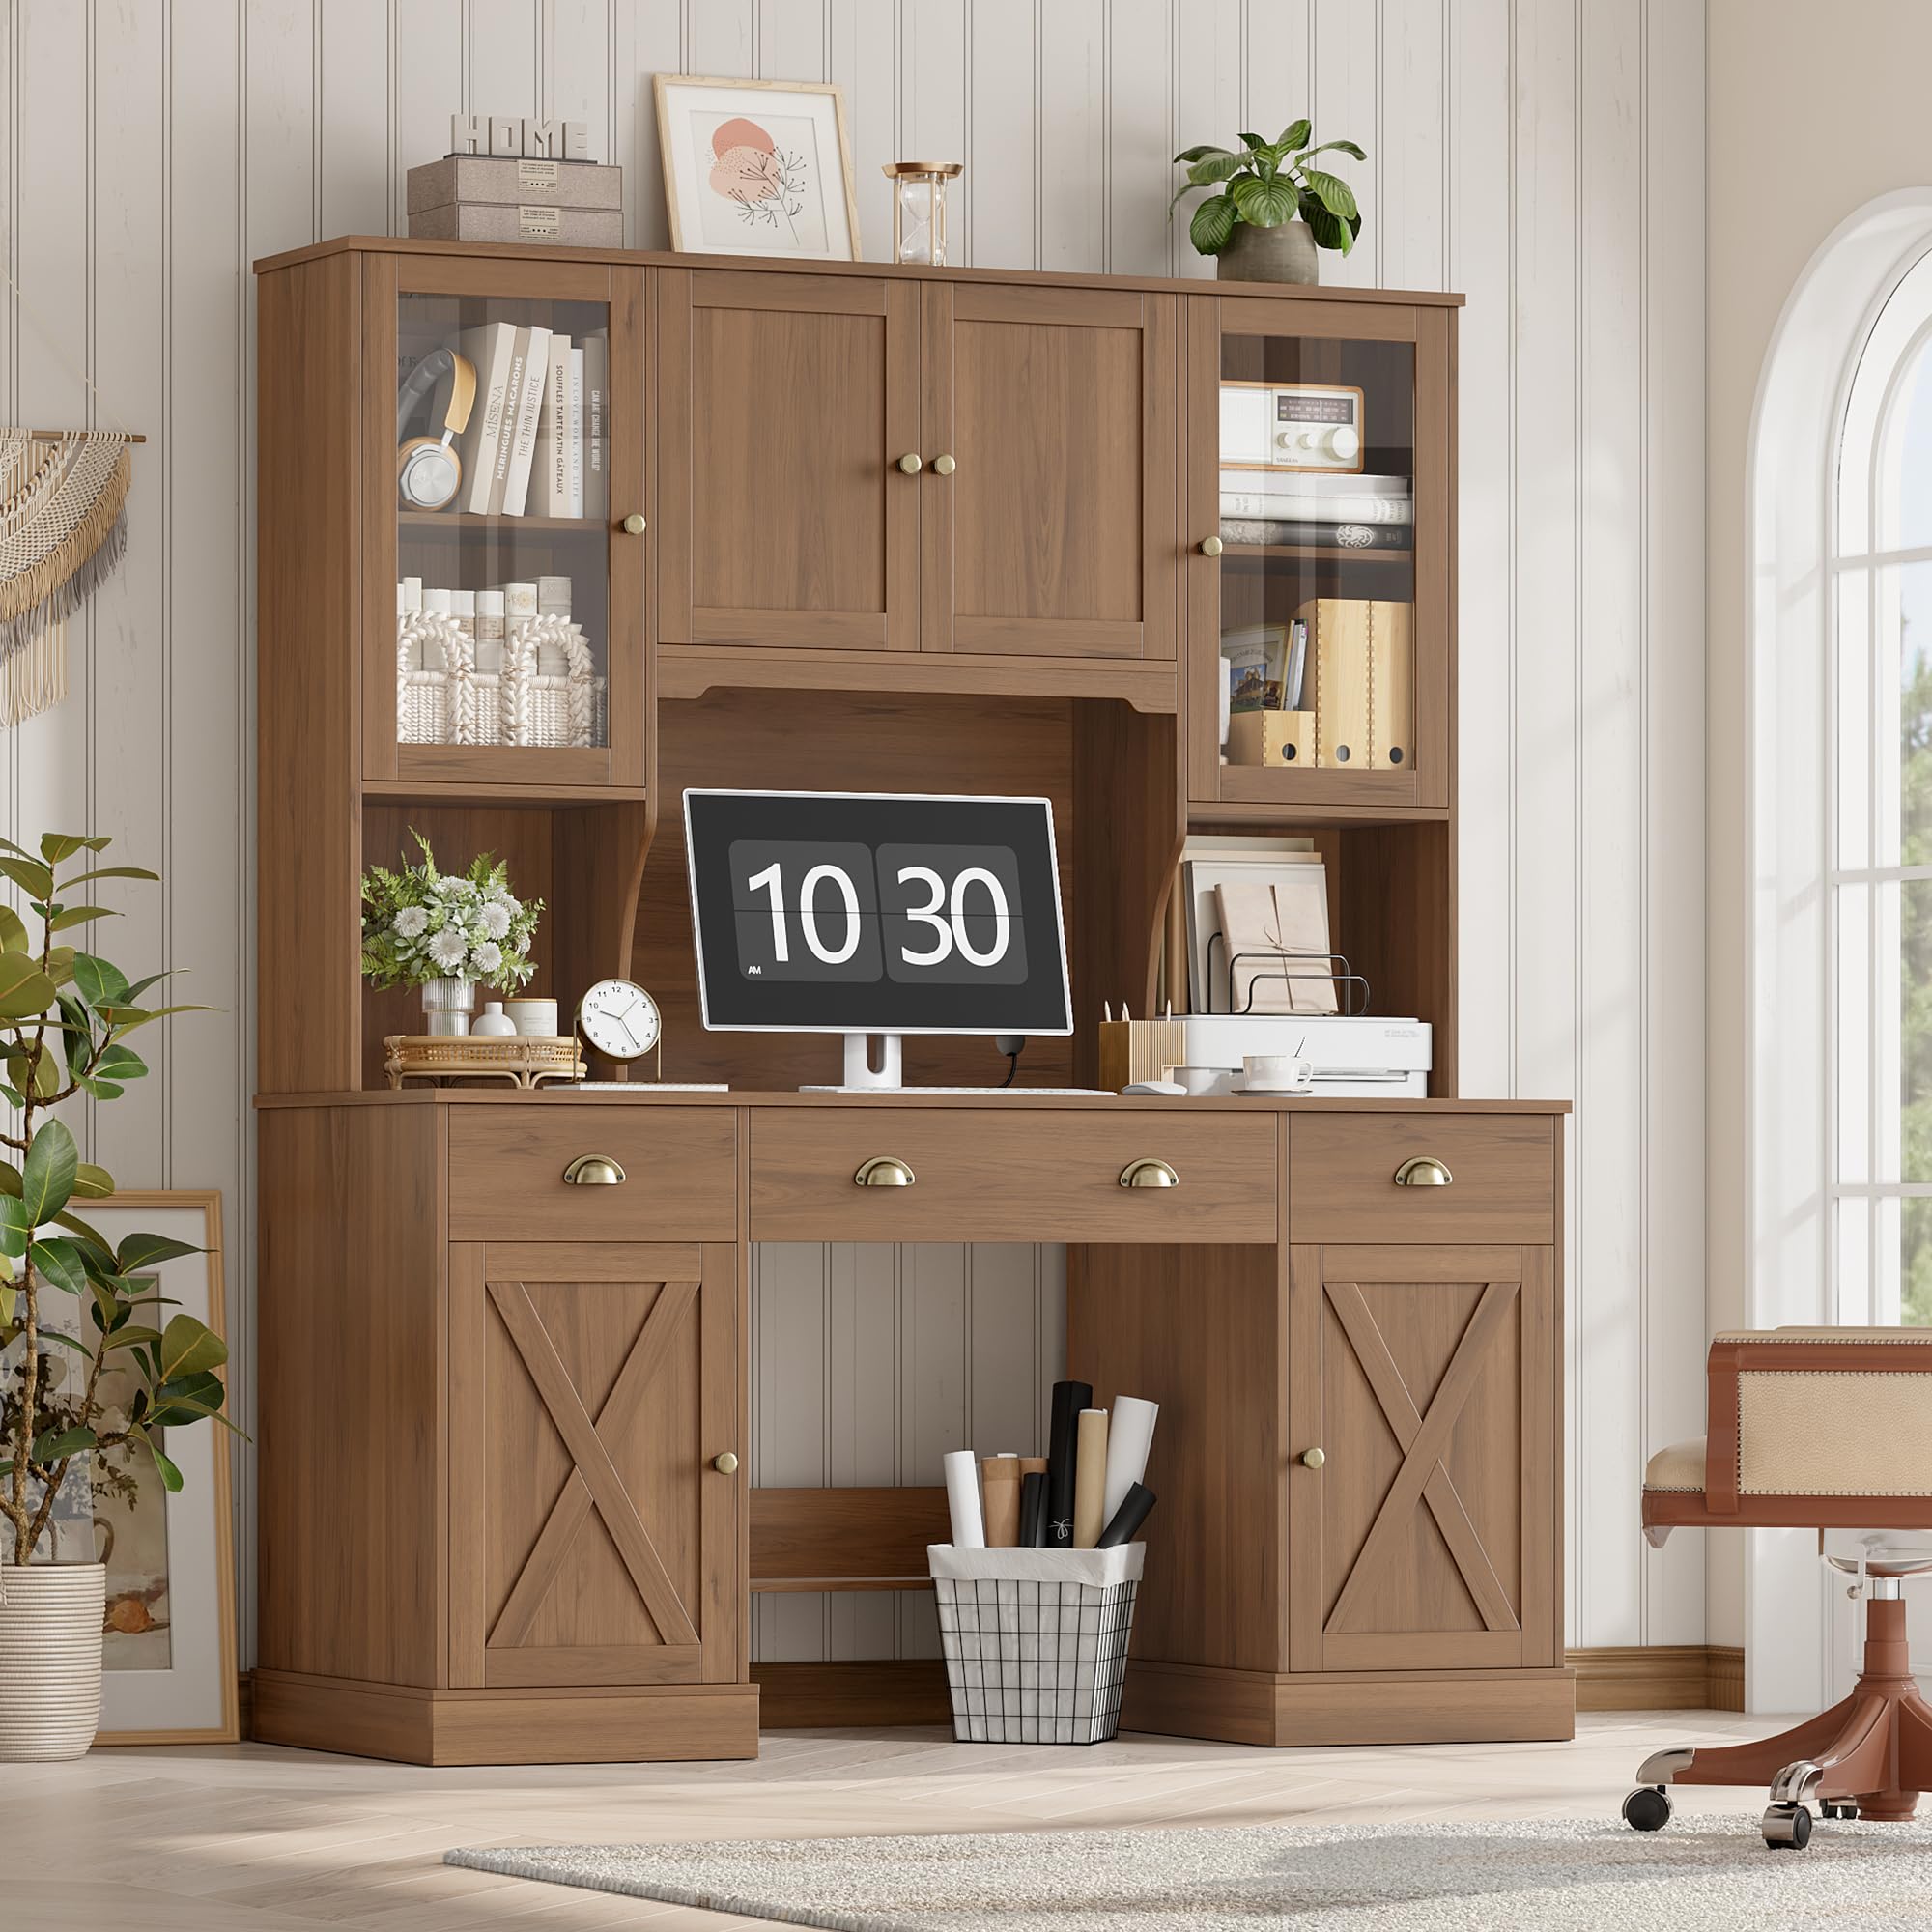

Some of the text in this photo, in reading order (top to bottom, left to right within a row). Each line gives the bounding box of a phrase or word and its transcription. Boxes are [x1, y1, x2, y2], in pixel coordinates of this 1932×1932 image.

[451, 114, 587, 159] HOME
[497, 356, 523, 480] MERINGUES MACARONS
[519, 377, 540, 457] THE THIN JUSTICE
[591, 390, 600, 402] CAN
[591, 438, 600, 448] THE
[748, 863, 1009, 967] 10 30
[748, 965, 761, 975] AM
